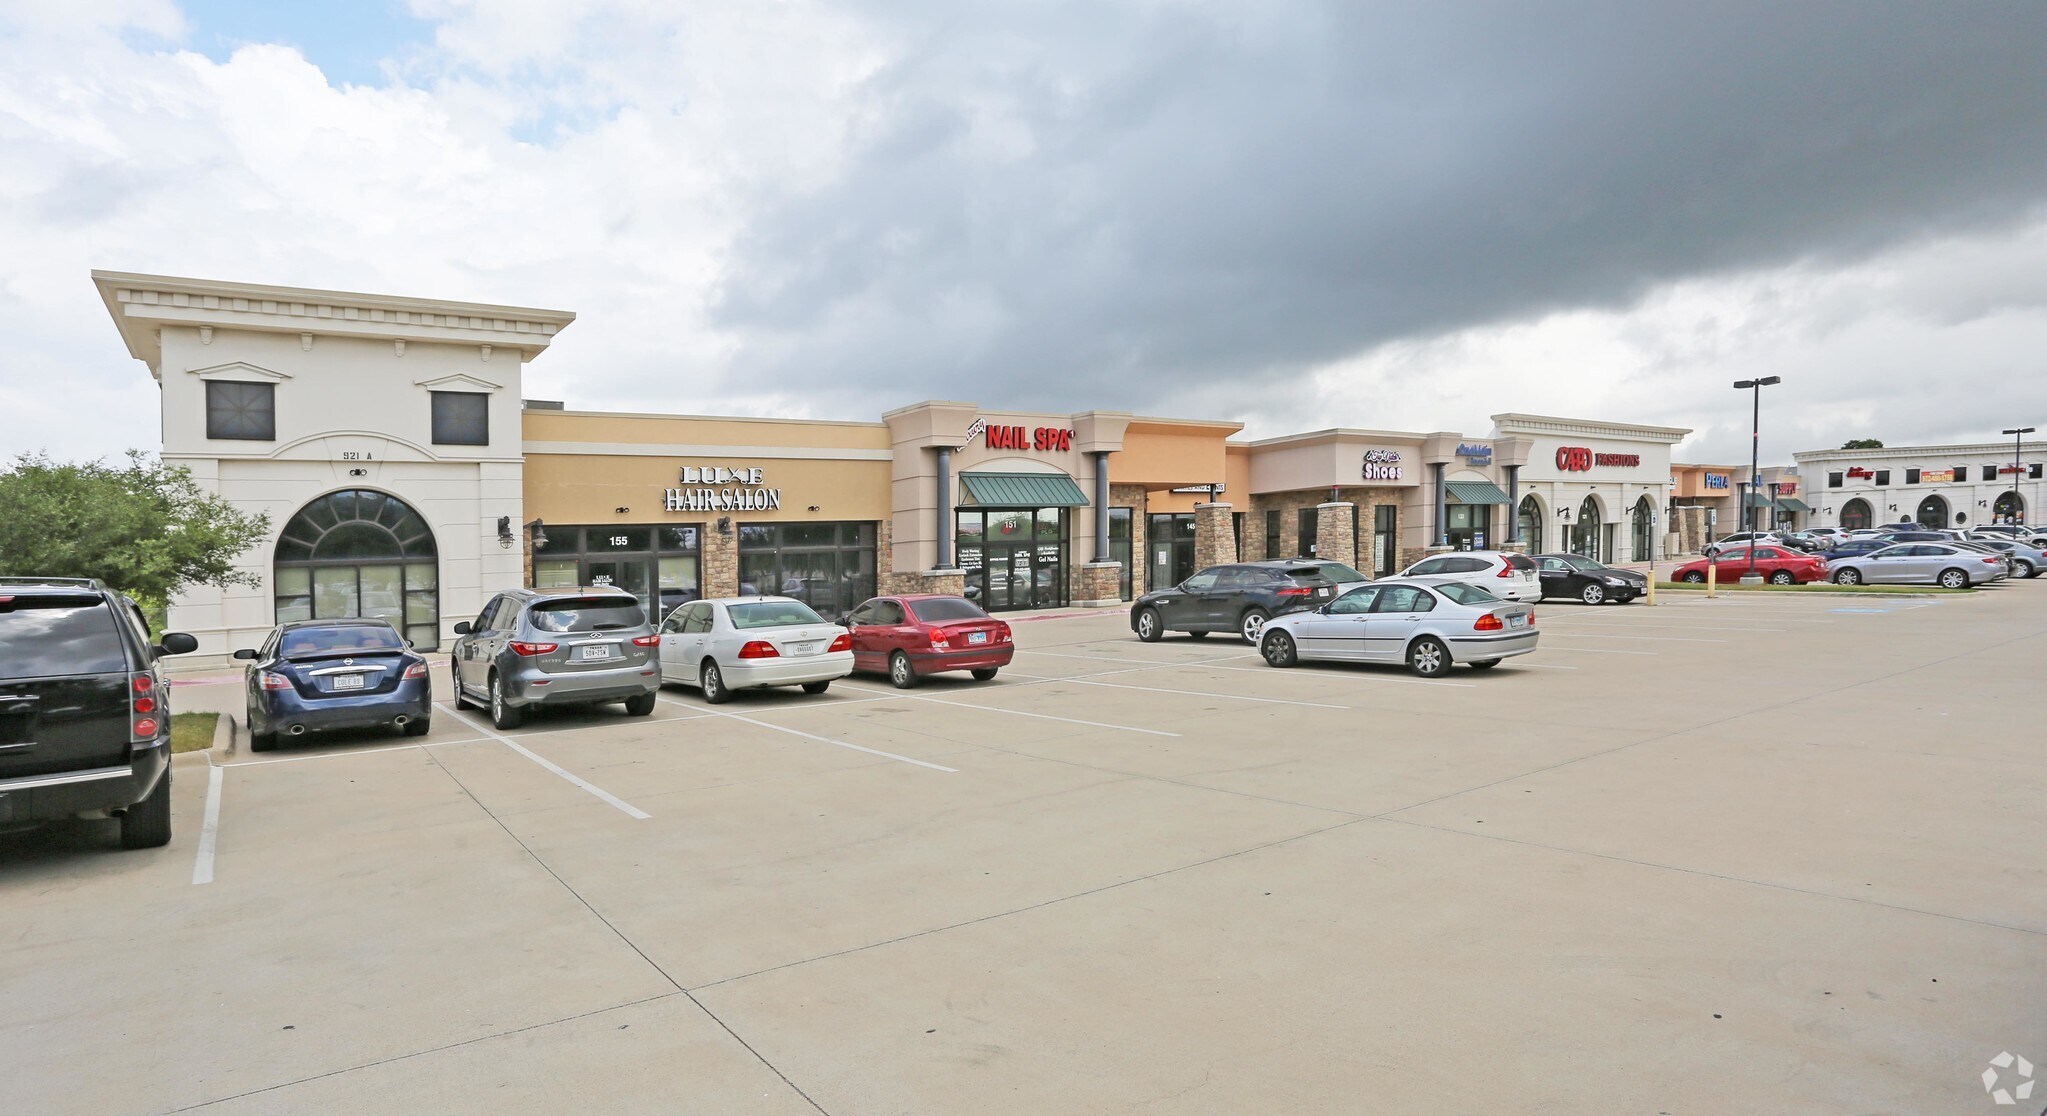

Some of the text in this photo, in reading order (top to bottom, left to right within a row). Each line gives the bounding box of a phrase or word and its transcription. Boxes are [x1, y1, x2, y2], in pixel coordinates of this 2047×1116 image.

[986, 425, 1070, 451] NAIL SPA
[343, 452, 372, 460] 921 A
[1556, 447, 1640, 471] CATO FASHIONS
[681, 466, 764, 485] LUXE
[1364, 463, 1402, 479] Shoes
[1705, 472, 1729, 489] PERLA
[664, 488, 780, 512] HAIR SALON
[610, 536, 628, 546] 155
